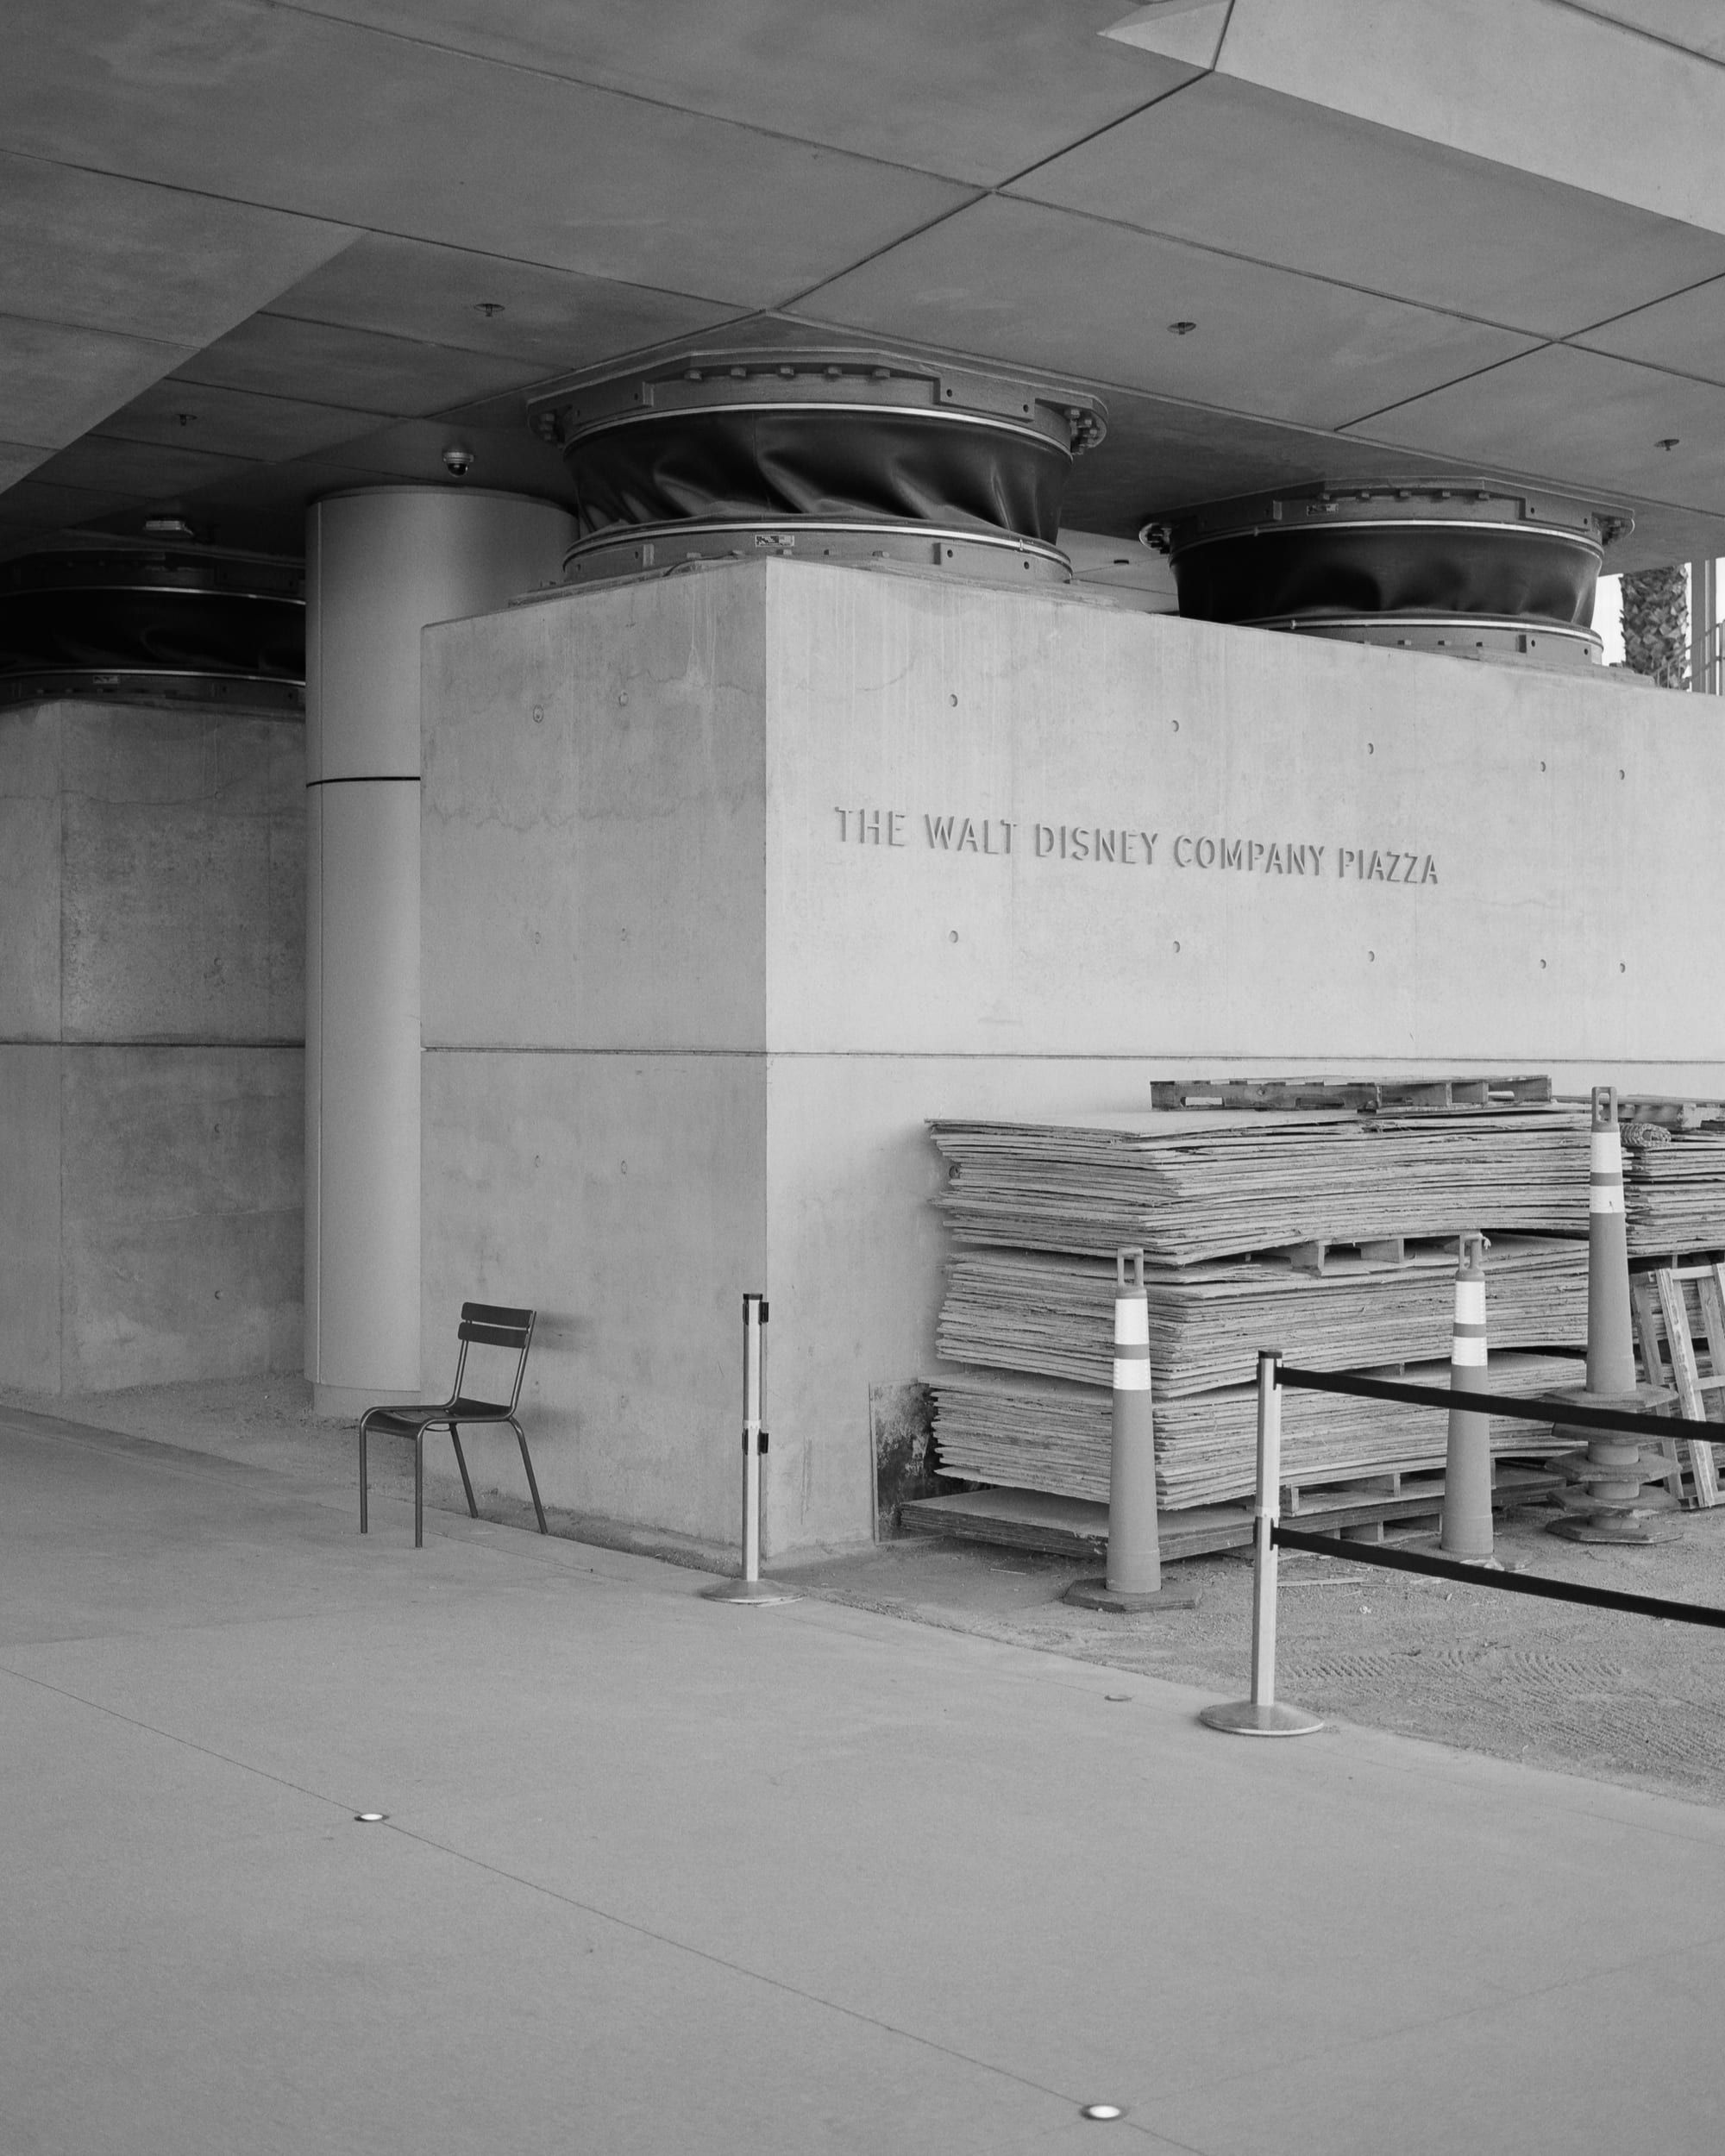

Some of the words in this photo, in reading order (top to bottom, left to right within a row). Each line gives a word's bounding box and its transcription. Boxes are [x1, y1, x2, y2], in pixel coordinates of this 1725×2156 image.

[835, 806, 905, 847] THE
[924, 813, 1018, 855] WALT
[1035, 824, 1158, 866] DISNEY
[1173, 834, 1325, 876] COMPANY
[1339, 847, 1439, 885] PIAZZA
